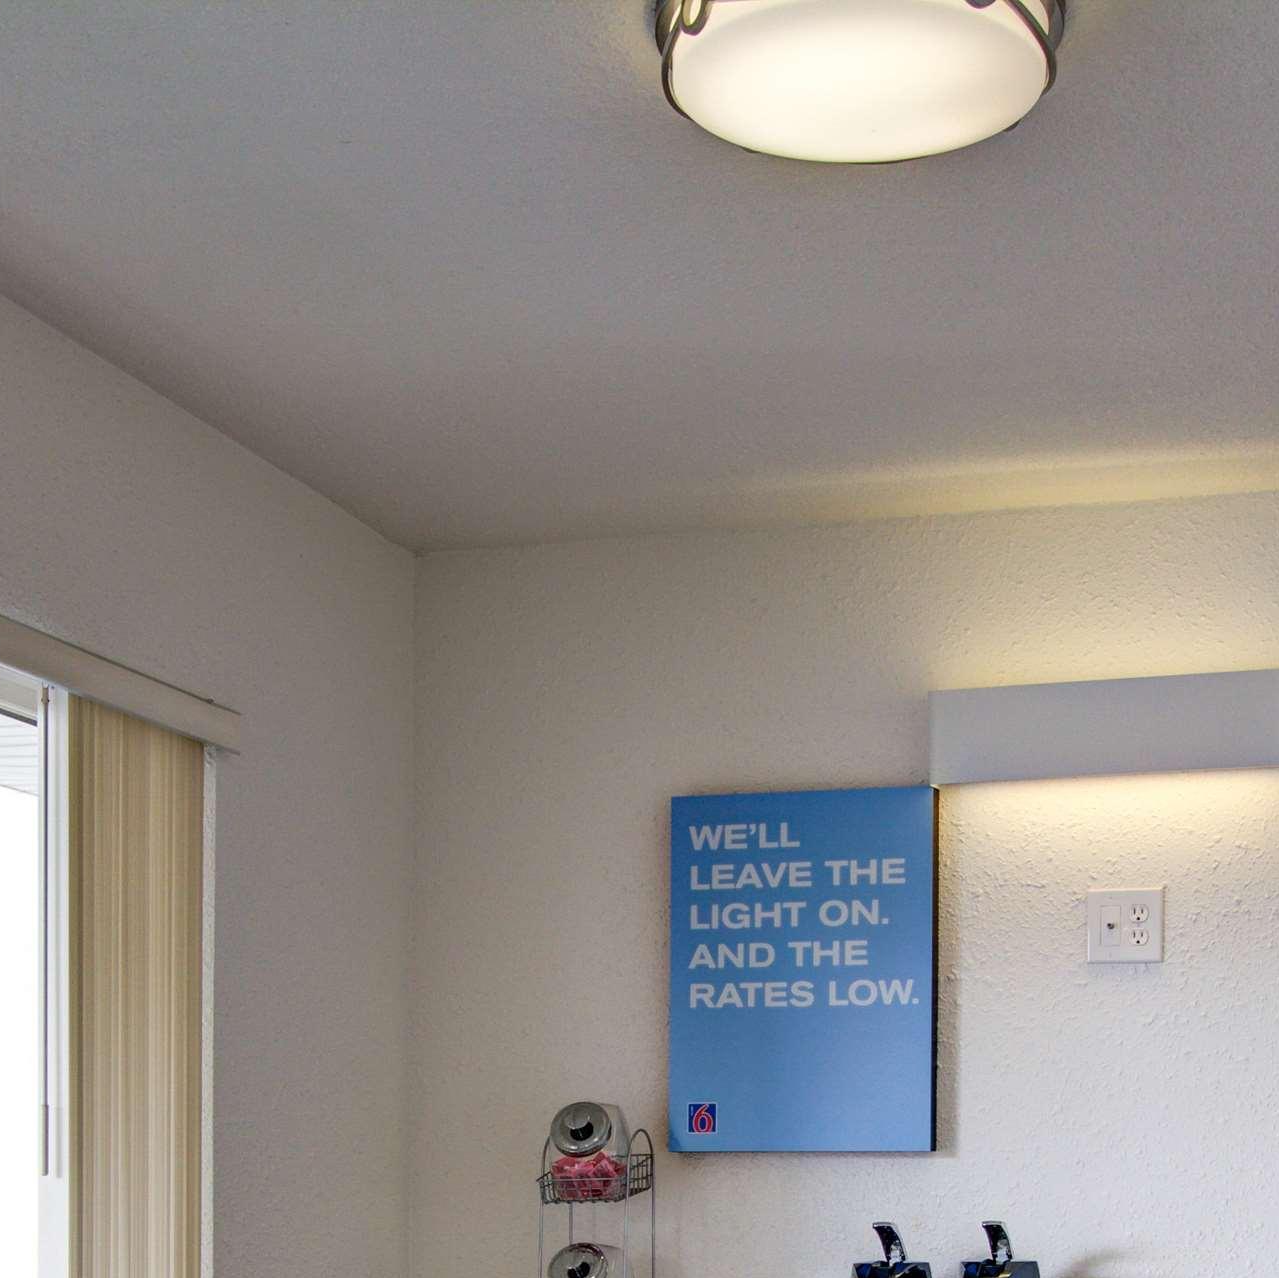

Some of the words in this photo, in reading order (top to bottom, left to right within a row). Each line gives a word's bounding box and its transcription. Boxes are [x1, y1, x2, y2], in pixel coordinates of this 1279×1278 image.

[689, 822, 800, 850] WE’LL
[690, 860, 812, 891] LEAVE
[824, 857, 906, 886] THE
[690, 901, 807, 930] LIGHT
[818, 899, 889, 927] ON.
[689, 942, 775, 969] AND
[787, 939, 869, 967] THE
[689, 981, 815, 1009] RATES
[828, 978, 921, 1007] LOW.
[692, 1103, 714, 1134] 6
